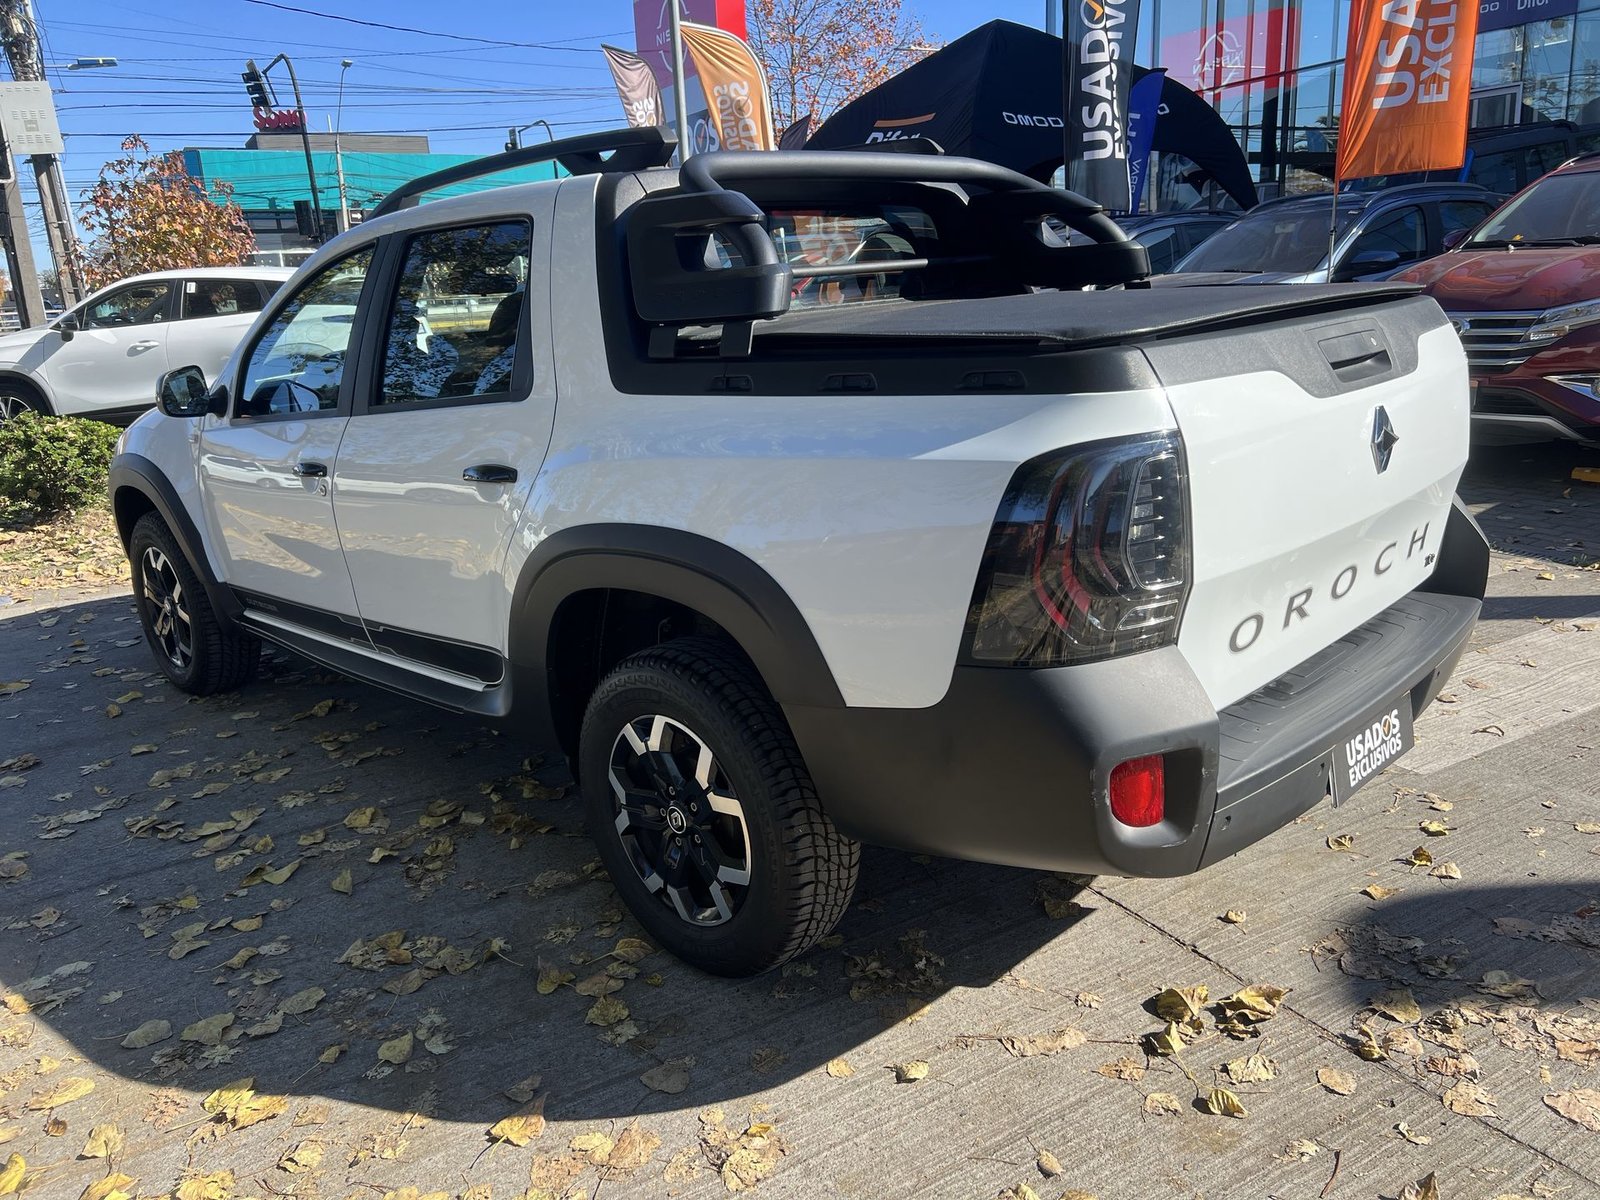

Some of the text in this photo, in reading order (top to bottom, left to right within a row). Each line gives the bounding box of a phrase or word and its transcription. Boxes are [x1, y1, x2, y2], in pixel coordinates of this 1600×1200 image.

[1417, 0, 1457, 104] EXCL
[1228, 521, 1430, 653] OROCH
[1345, 708, 1400, 767] USADOS
[1348, 732, 1402, 788] EXCLUSIVOS
